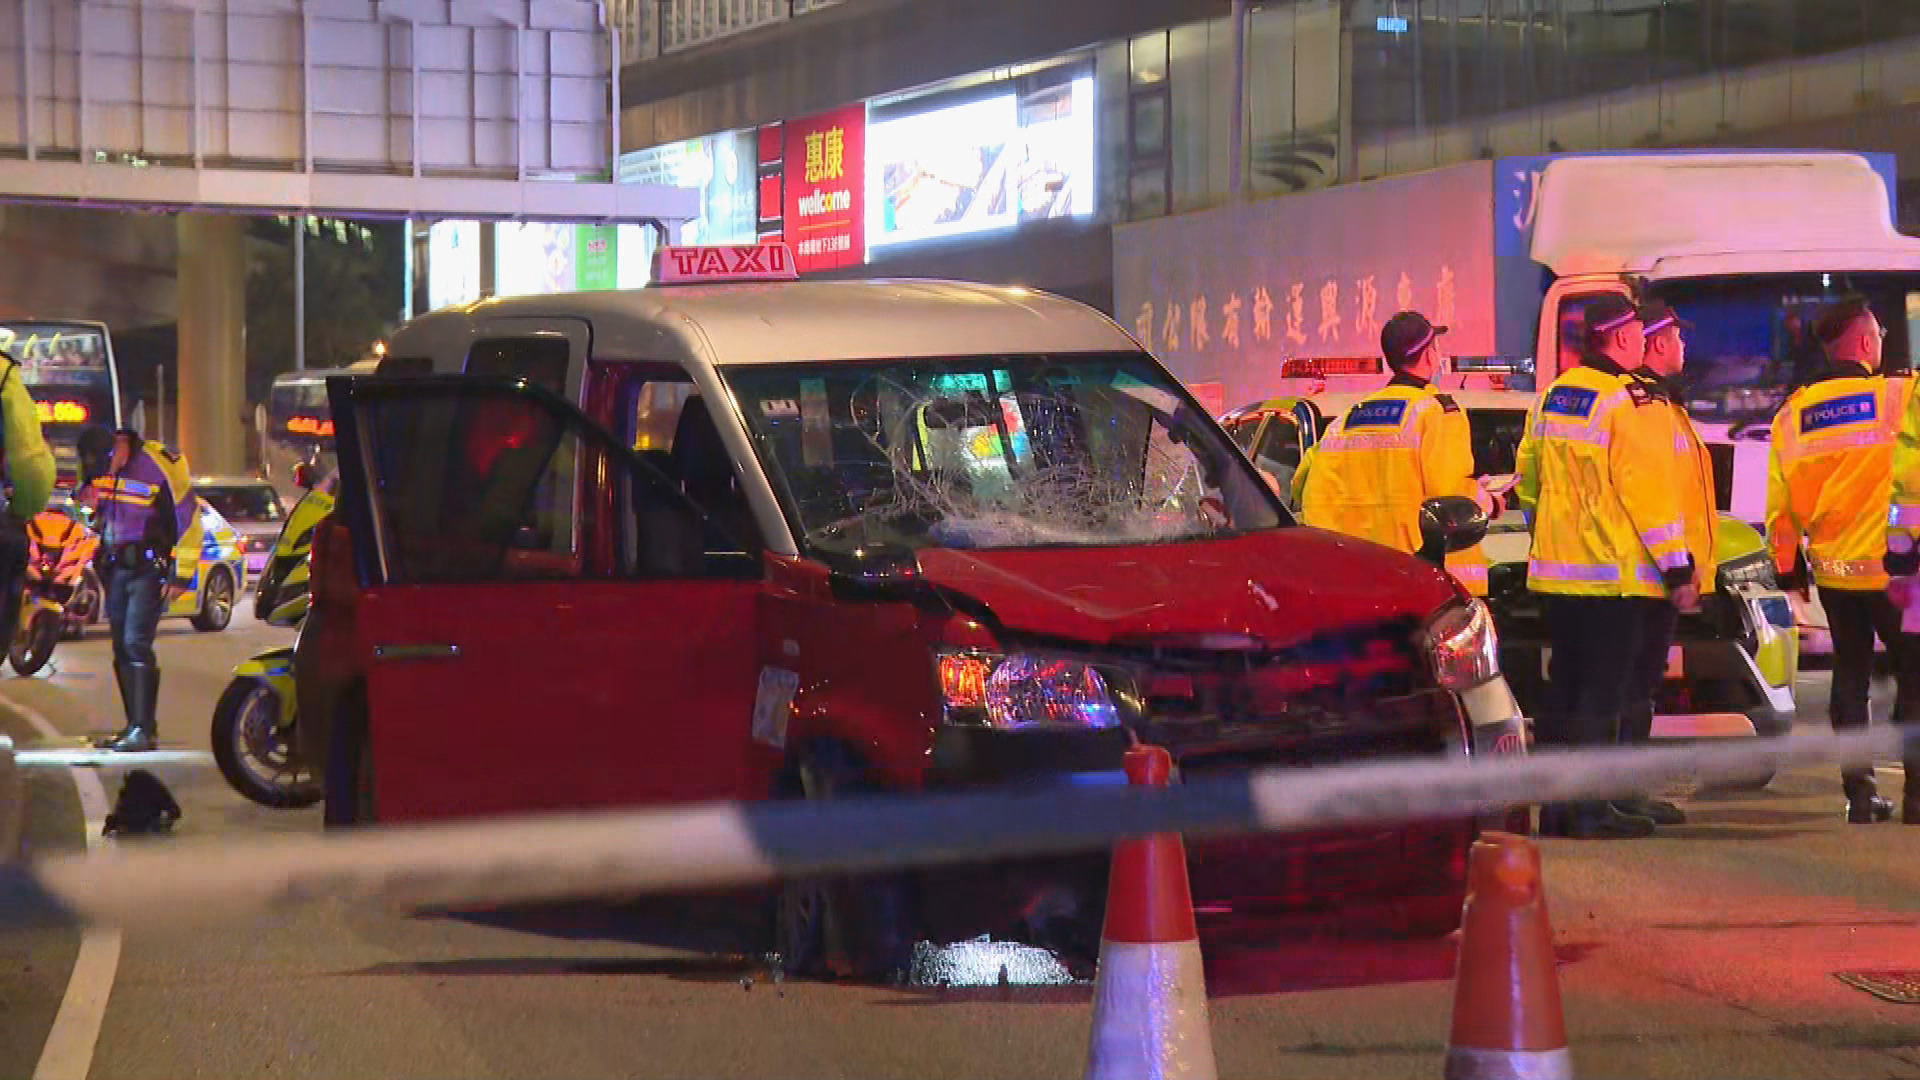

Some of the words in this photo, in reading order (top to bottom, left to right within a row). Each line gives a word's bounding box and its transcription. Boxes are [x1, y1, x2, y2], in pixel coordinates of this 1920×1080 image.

[804, 125, 845, 184] 惠康
[798, 188, 851, 217] wellcome
[670, 245, 785, 275] TAXI
[1814, 403, 1856, 420] POLICE
